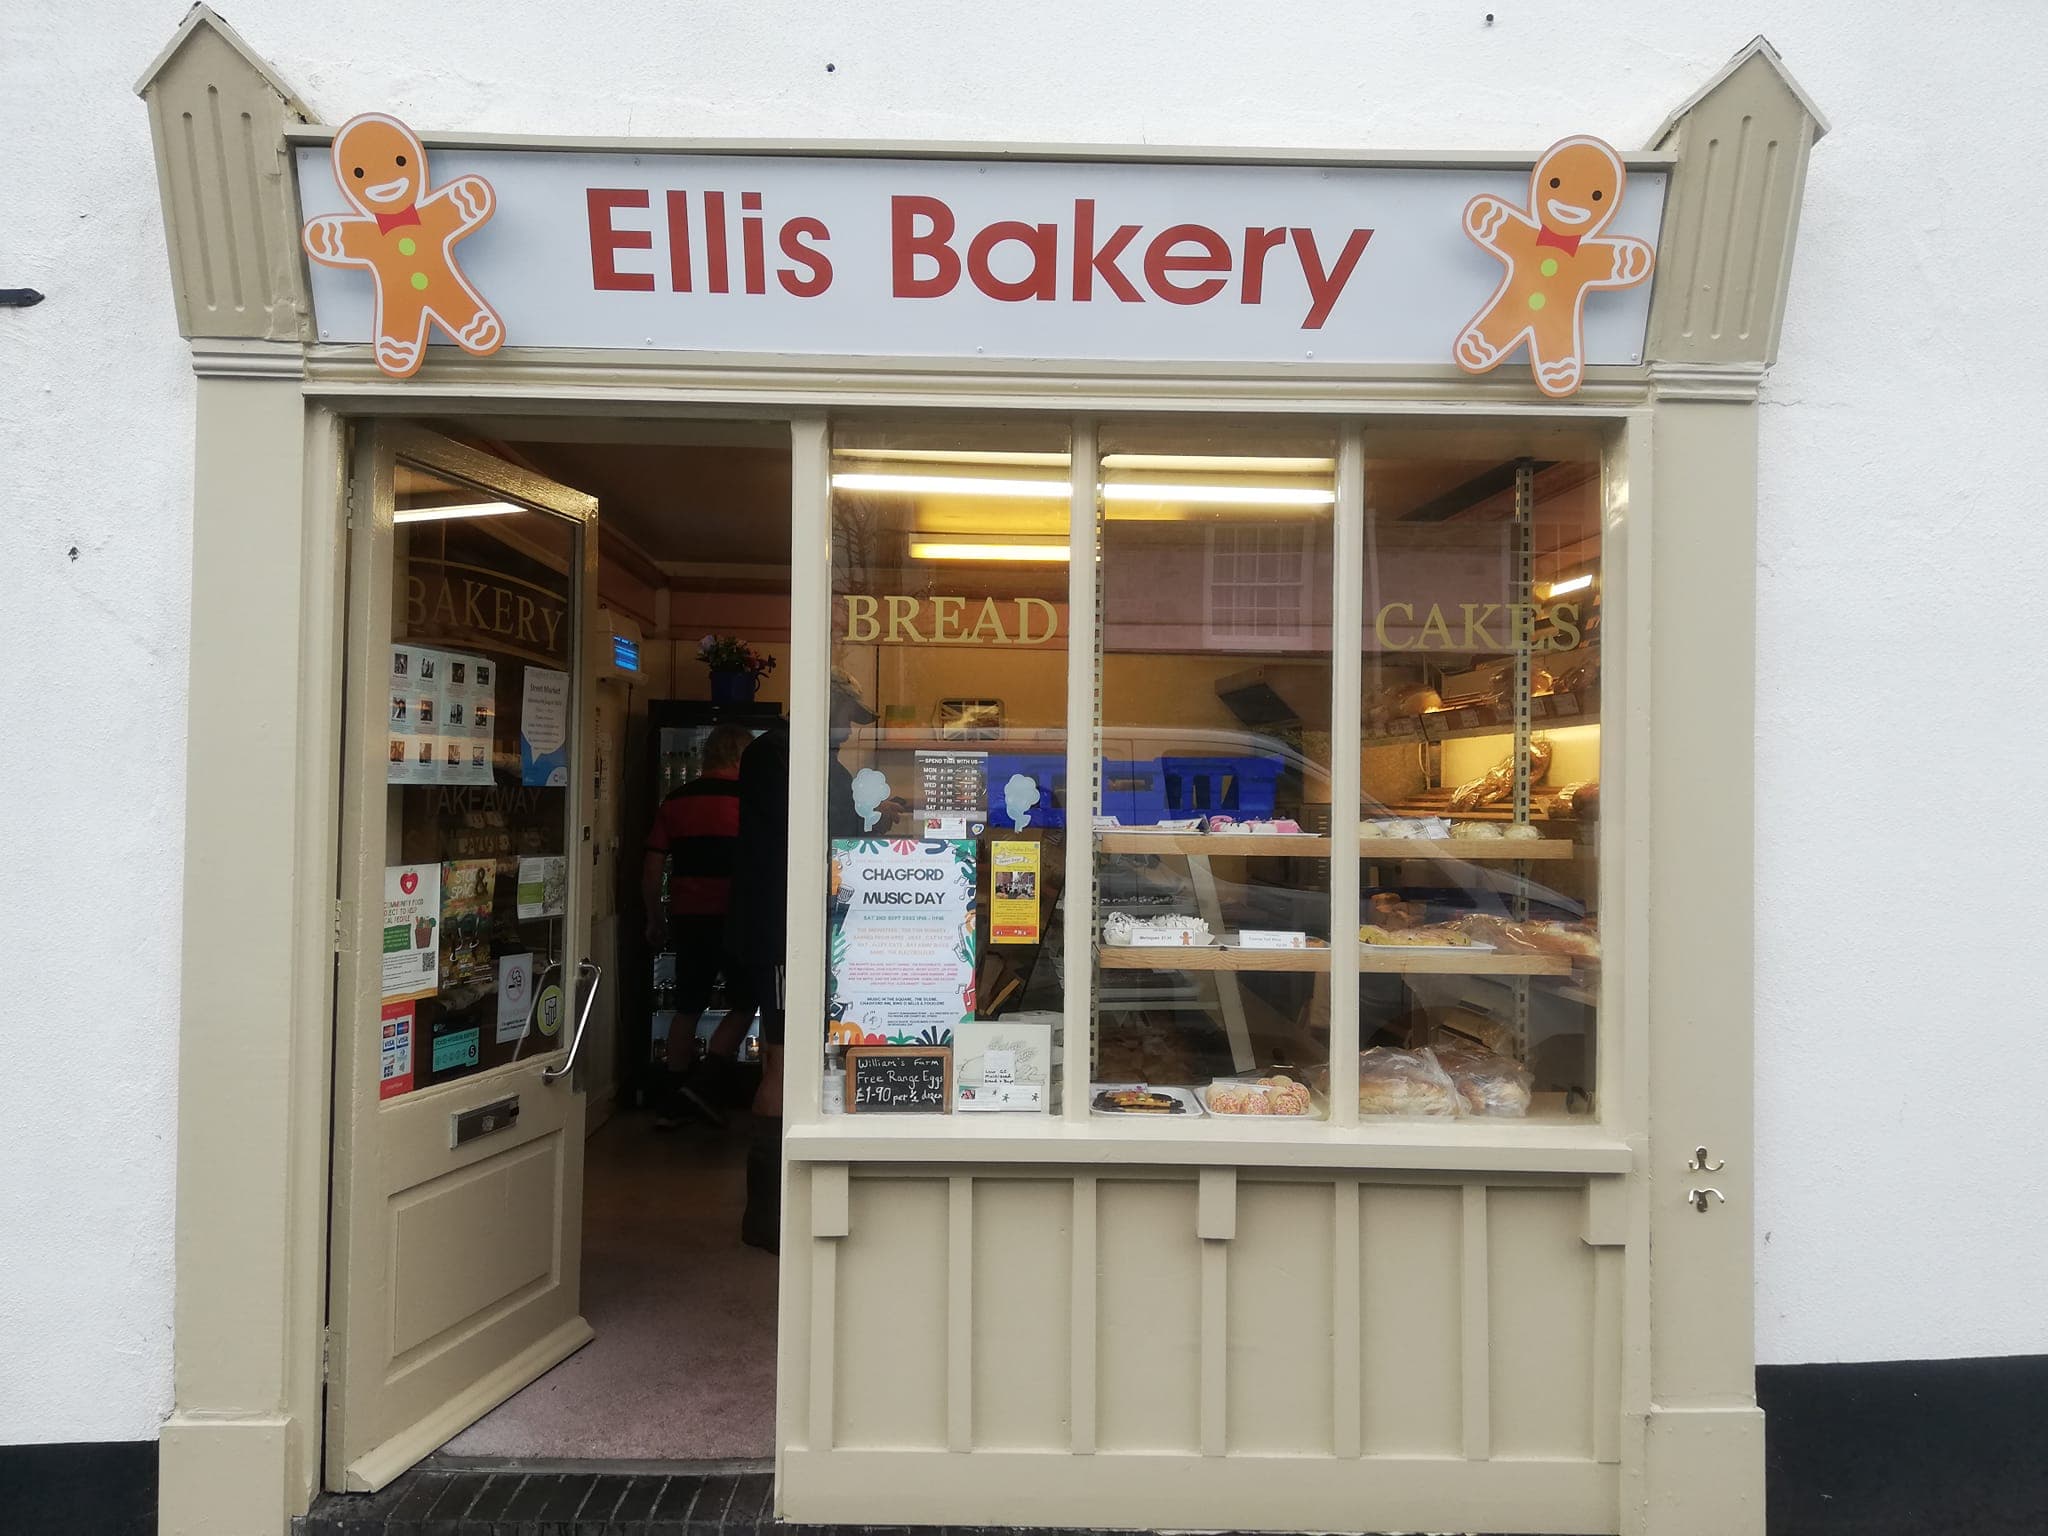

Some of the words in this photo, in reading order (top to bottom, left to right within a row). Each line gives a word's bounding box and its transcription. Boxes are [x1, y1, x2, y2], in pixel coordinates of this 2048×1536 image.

[586, 188, 833, 298] Ellis
[891, 195, 1375, 330] Bakery
[407, 576, 564, 652] BAKERY
[843, 595, 1058, 644] BREAD
[1375, 602, 1581, 651] CAKES
[421, 786, 542, 816] TAKEAWAY
[862, 868, 944, 881] CHAGFORD
[863, 891, 913, 905] MUSIC
[915, 891, 946, 905] DAY
[384, 1040, 395, 1048] VISA
[398, 1036, 409, 1044] VISA
[470, 1046, 475, 1056] 5
[858, 1058, 906, 1069] William's
[914, 1058, 939, 1066] Farm
[857, 1071, 884, 1084] Free
[886, 1070, 920, 1090] Range
[922, 1070, 944, 1090] Eggs
[893, 1094, 908, 1106] per
[921, 1089, 943, 1104] dozen
